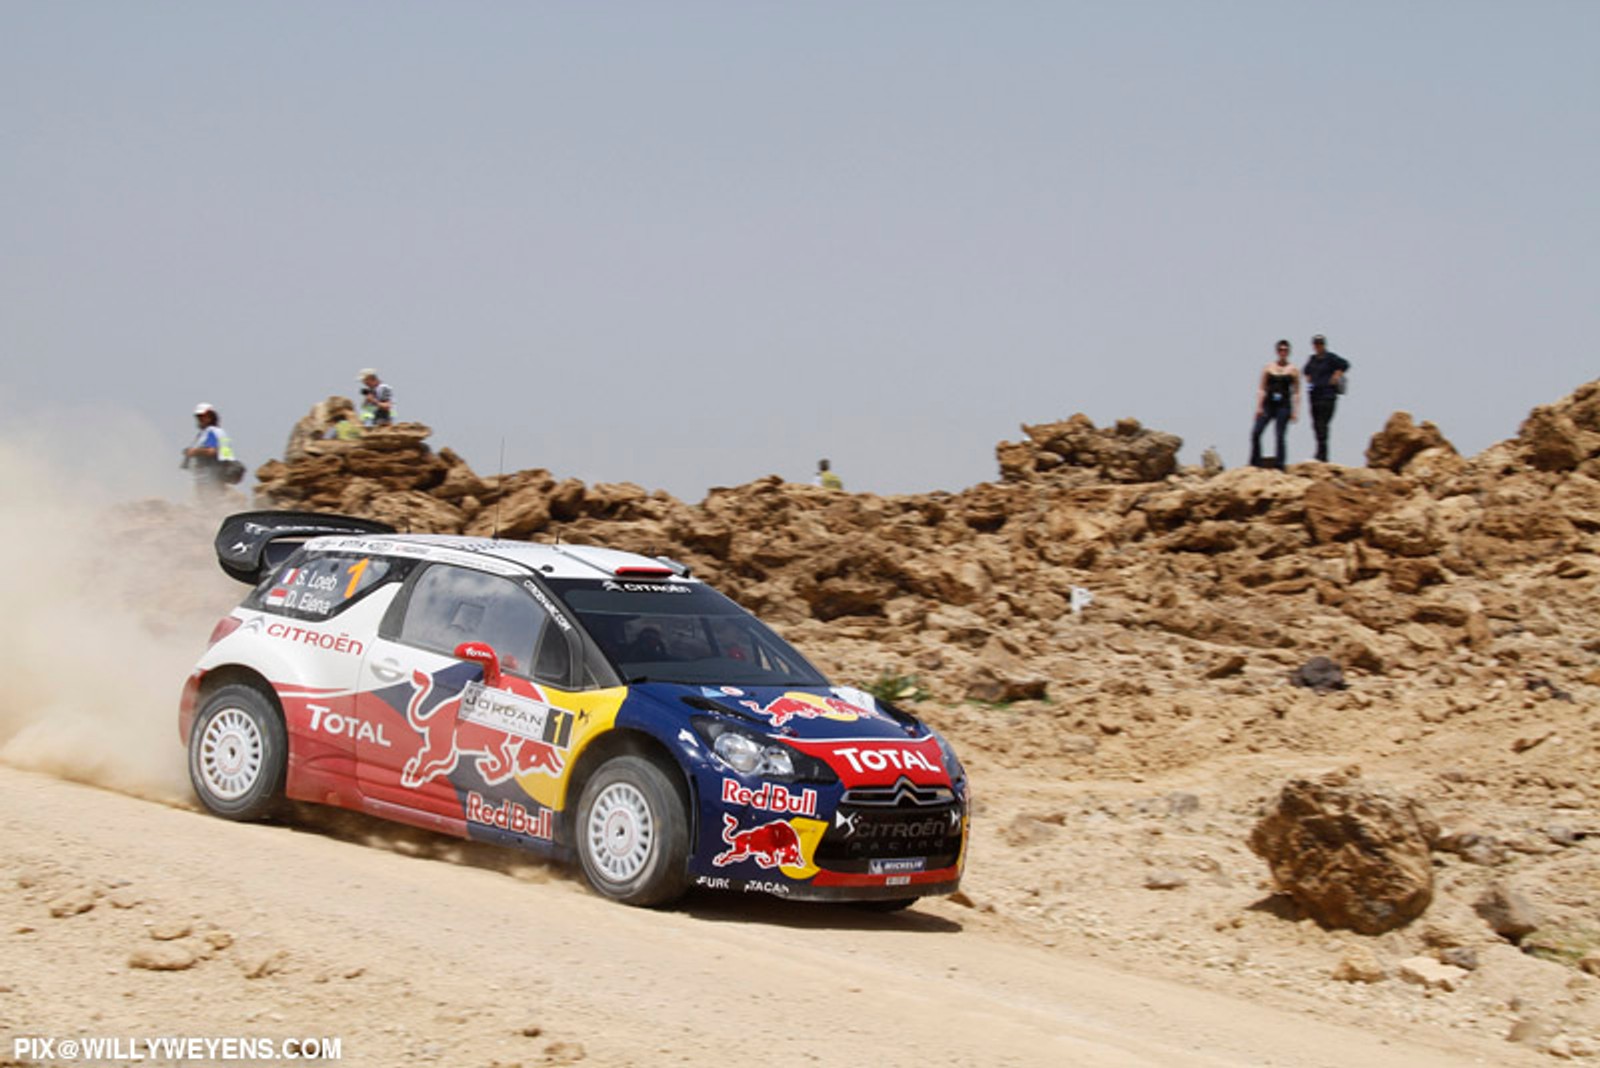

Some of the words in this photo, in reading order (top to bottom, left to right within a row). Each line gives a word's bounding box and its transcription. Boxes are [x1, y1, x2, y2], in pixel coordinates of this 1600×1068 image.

[296, 569, 309, 586] S.
[308, 570, 338, 591] Loeb
[344, 558, 369, 599] 1
[298, 592, 331, 615] Elena
[305, 703, 392, 747] TOTAL
[465, 695, 543, 727] JORDAN
[833, 748, 942, 773] TOTAL
[721, 778, 770, 811] Red
[770, 783, 818, 816] Bull
[466, 790, 510, 830] Red
[510, 802, 553, 841] Bull
